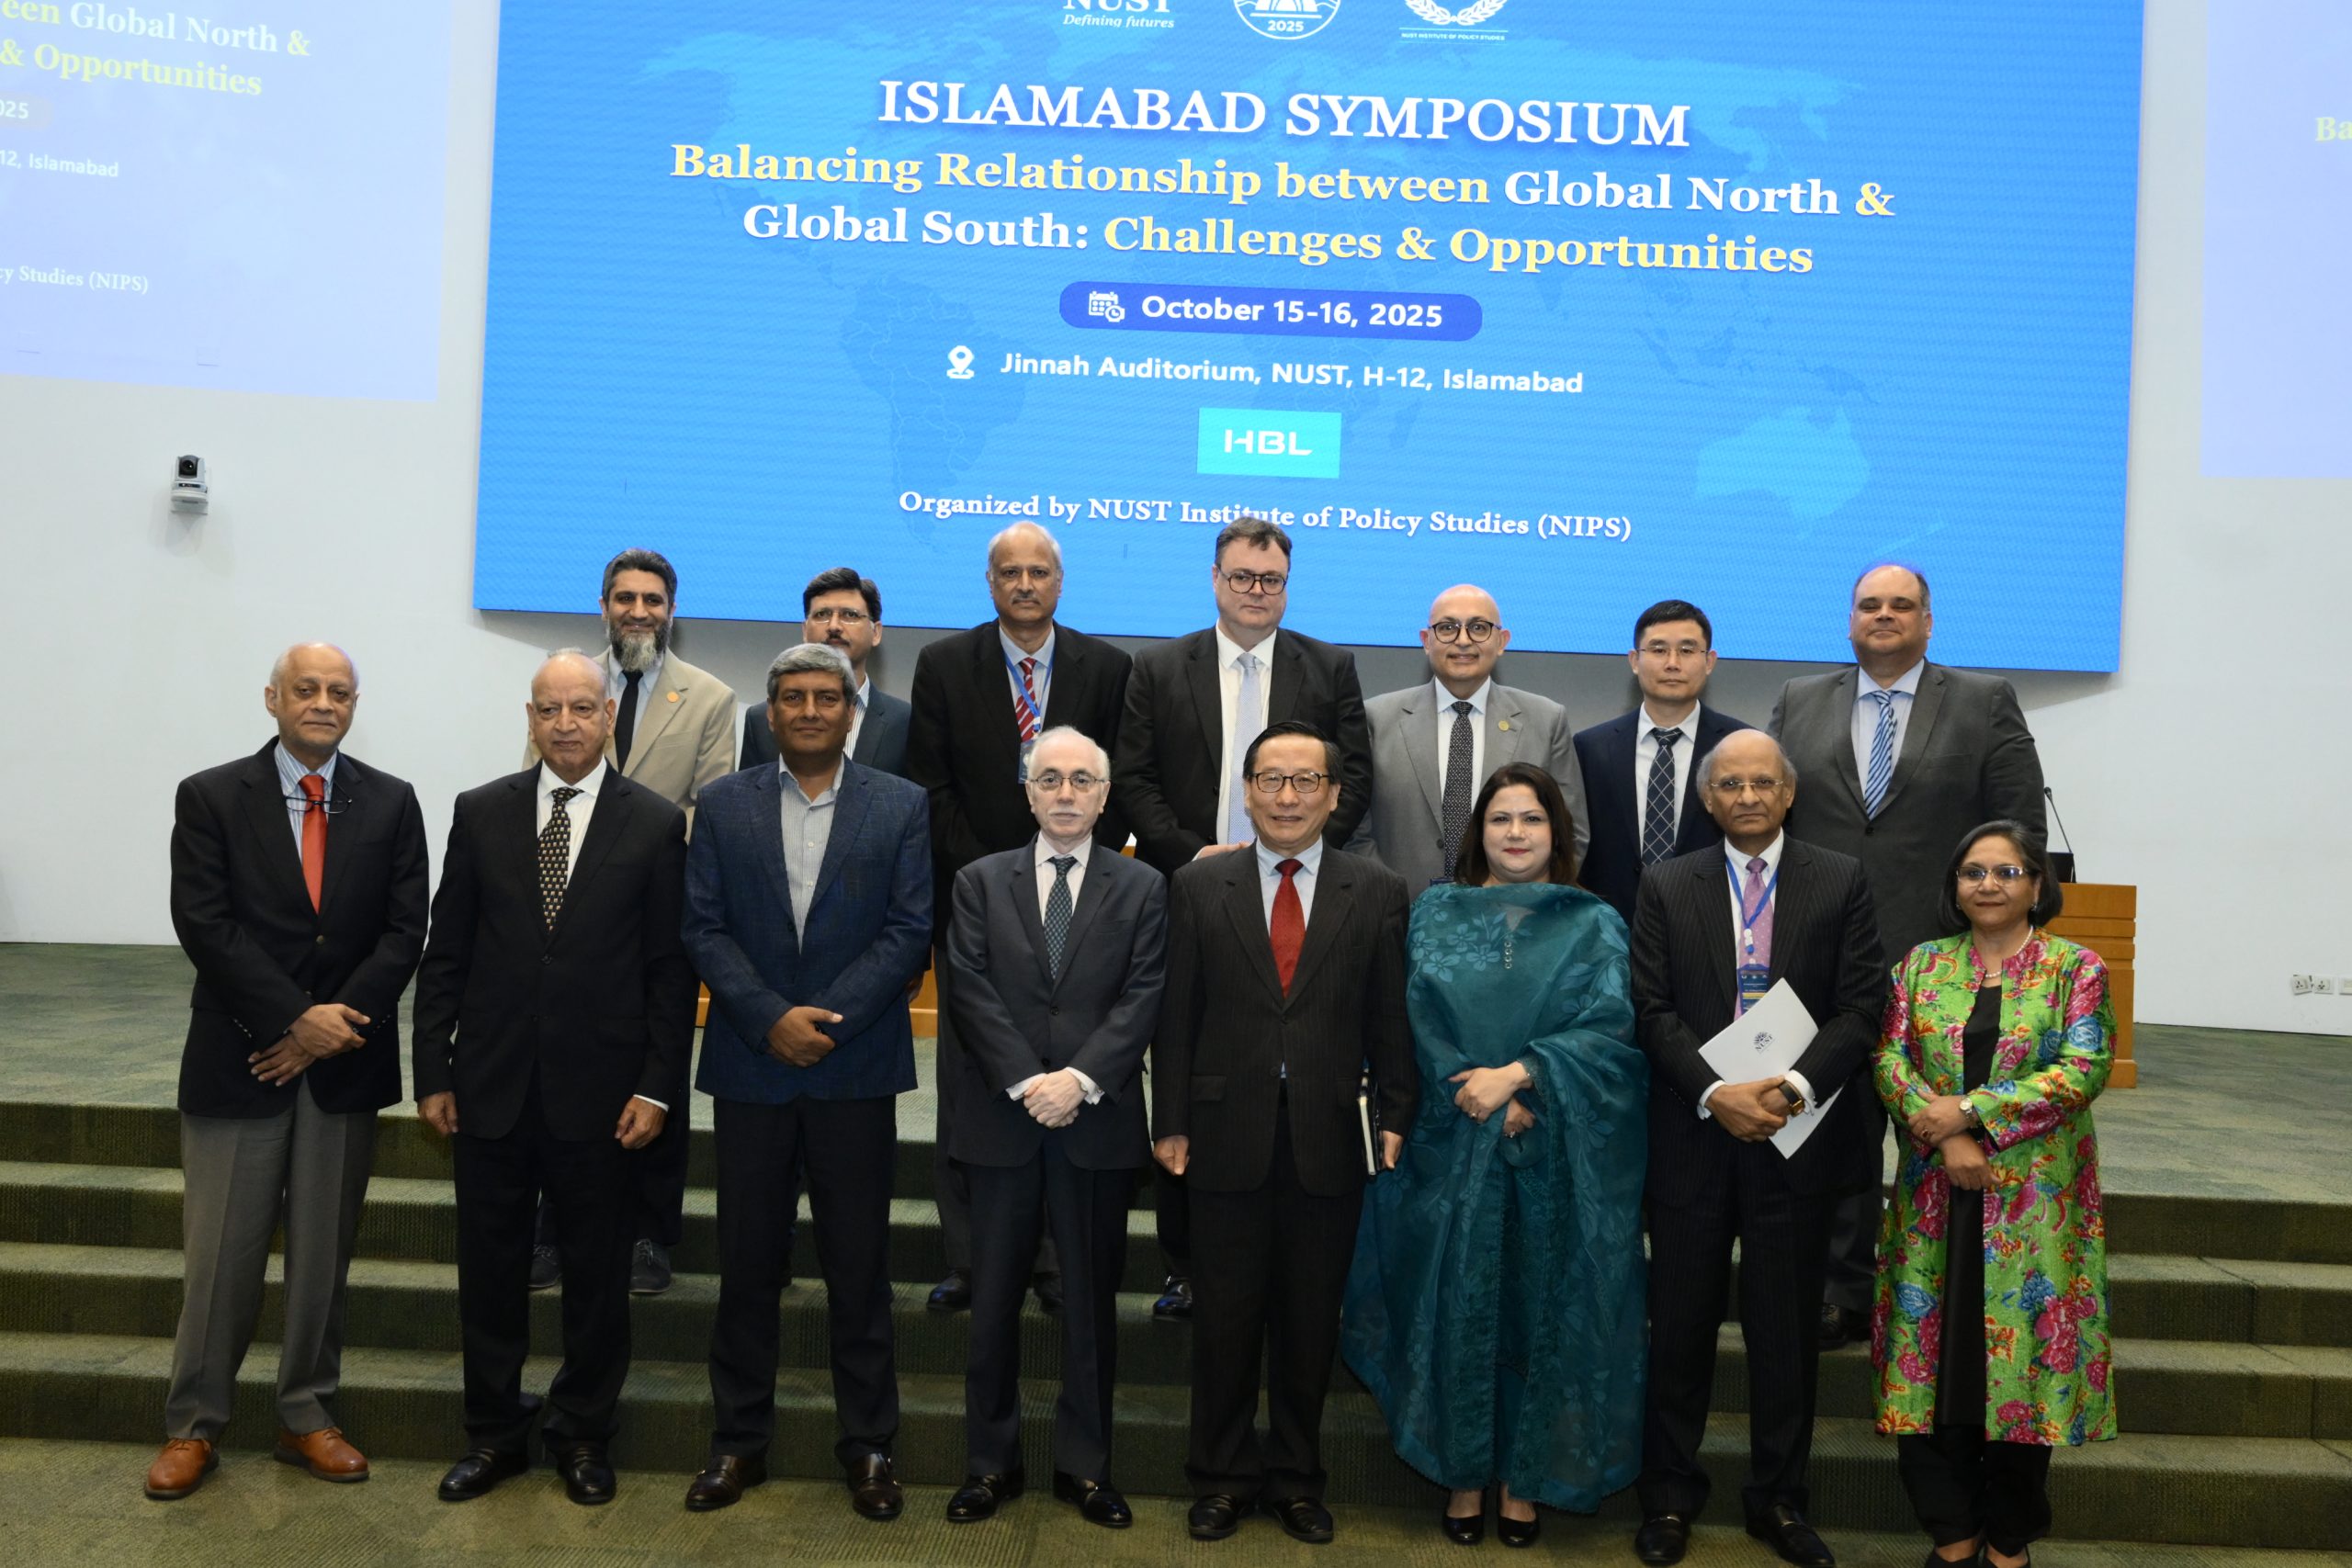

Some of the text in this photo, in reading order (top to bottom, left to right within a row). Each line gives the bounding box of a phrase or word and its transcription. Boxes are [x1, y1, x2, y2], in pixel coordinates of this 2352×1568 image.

[70, 2, 176, 39] Global
[185, 16, 278, 52] North
[287, 29, 311, 56] &
[1062, 14, 1175, 28] Defining futures
[1267, 19, 1305, 32] 2025
[0, 39, 263, 96] & Opportunities
[878, 80, 1690, 147] ISLAMABAD SYMPOSIUM
[28, 152, 119, 177] Islamabad
[670, 143, 1894, 216] Balancing Relationship between Global North &
[743, 203, 1813, 273] Global South: Challenges & Opportunities
[19, 265, 84, 287] Studies
[89, 271, 148, 295] (NIPS)
[1141, 295, 1442, 328] October 15-16, 2025
[1001, 353, 1583, 393] Jinnah Auditorium, NUST, H-12, Islamabad
[1225, 429, 1312, 456] HBL
[899, 491, 1040, 519] Organized
[1048, 495, 1081, 524] by
[1088, 498, 1172, 521] NUST
[1302, 505, 1334, 527] of
[1339, 507, 1423, 536] Policy
[1430, 511, 1530, 535] Studies
[1537, 513, 1632, 542] (NIPS)
